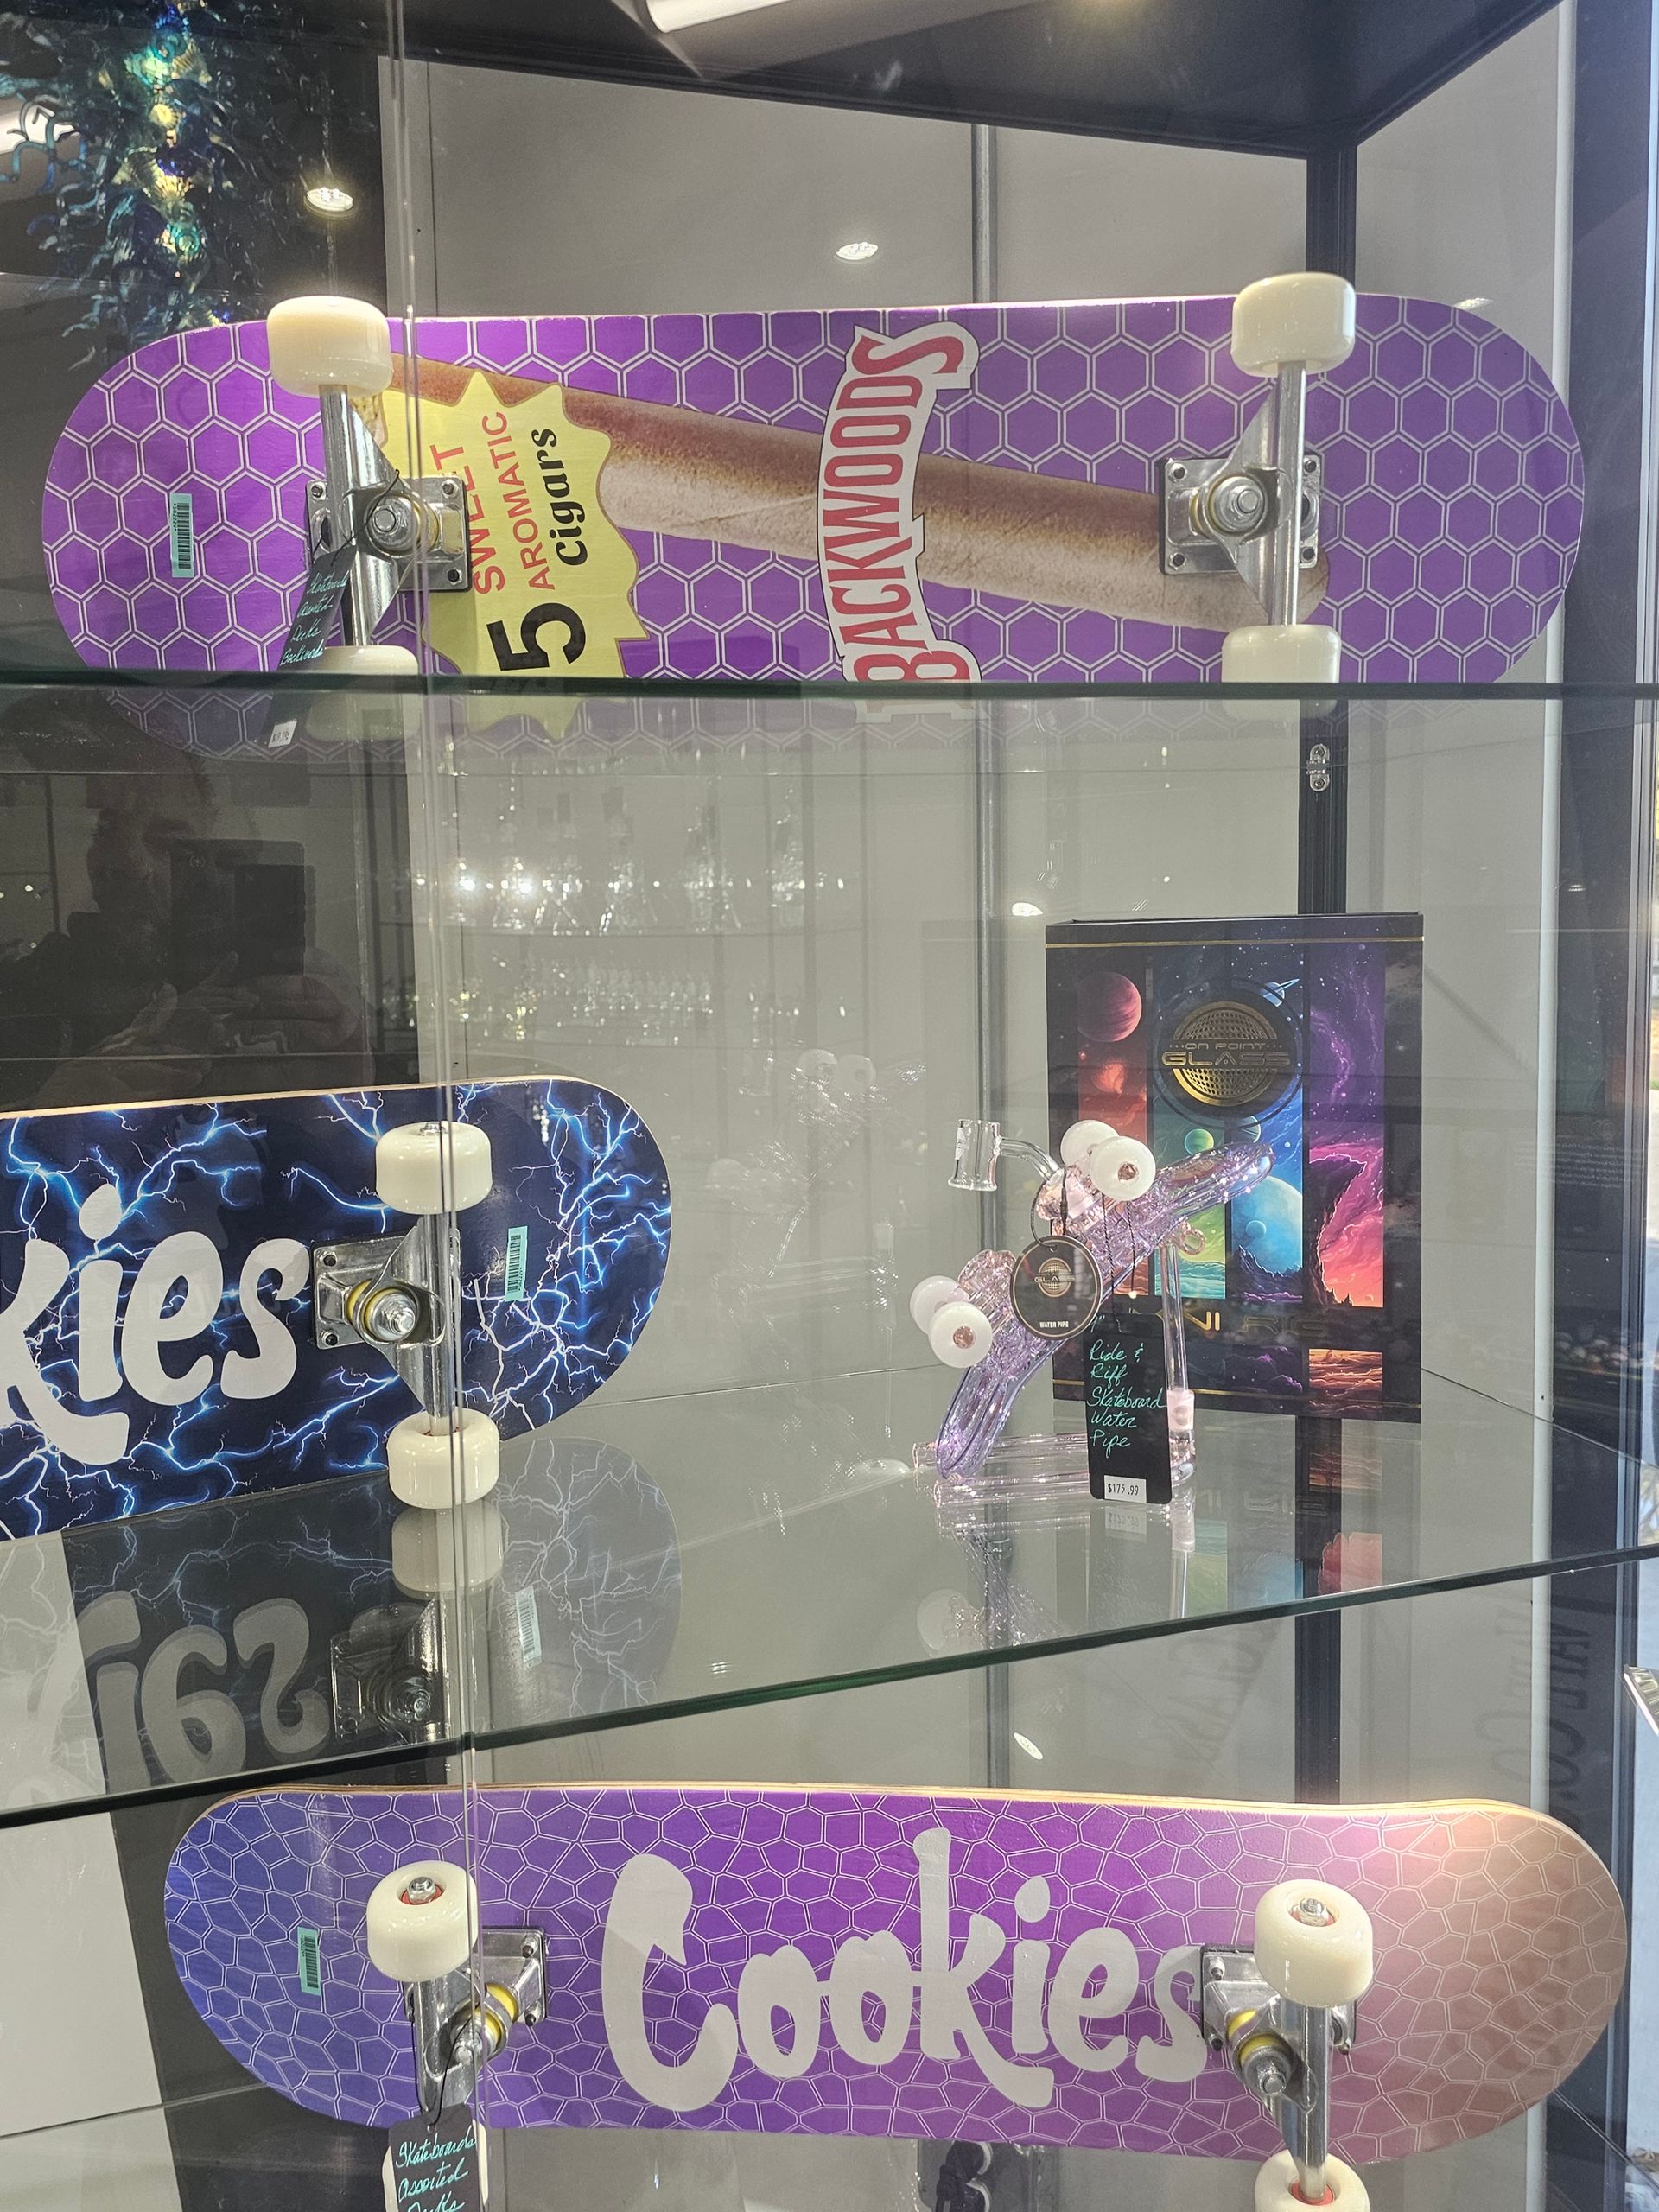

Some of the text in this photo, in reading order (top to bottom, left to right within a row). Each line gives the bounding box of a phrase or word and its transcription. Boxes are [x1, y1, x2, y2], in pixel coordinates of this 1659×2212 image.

[481, 411, 556, 591] AROMATIC
[531, 428, 588, 566] Cigars
[823, 334, 965, 682] BACKWOODS
[486, 601, 587, 672] 5
[1160, 1051, 1291, 1066] GLASS
[1039, 1320, 1056, 1329] WATER
[1089, 1338, 1128, 1362] Ride
[1090, 1363, 1128, 1387] Riff
[1090, 1407, 1137, 1428] Water
[1090, 1429, 1131, 1459] Pipe
[1107, 1483, 1140, 1497] $175.99
[601, 1826, 1208, 2112] Cookies
